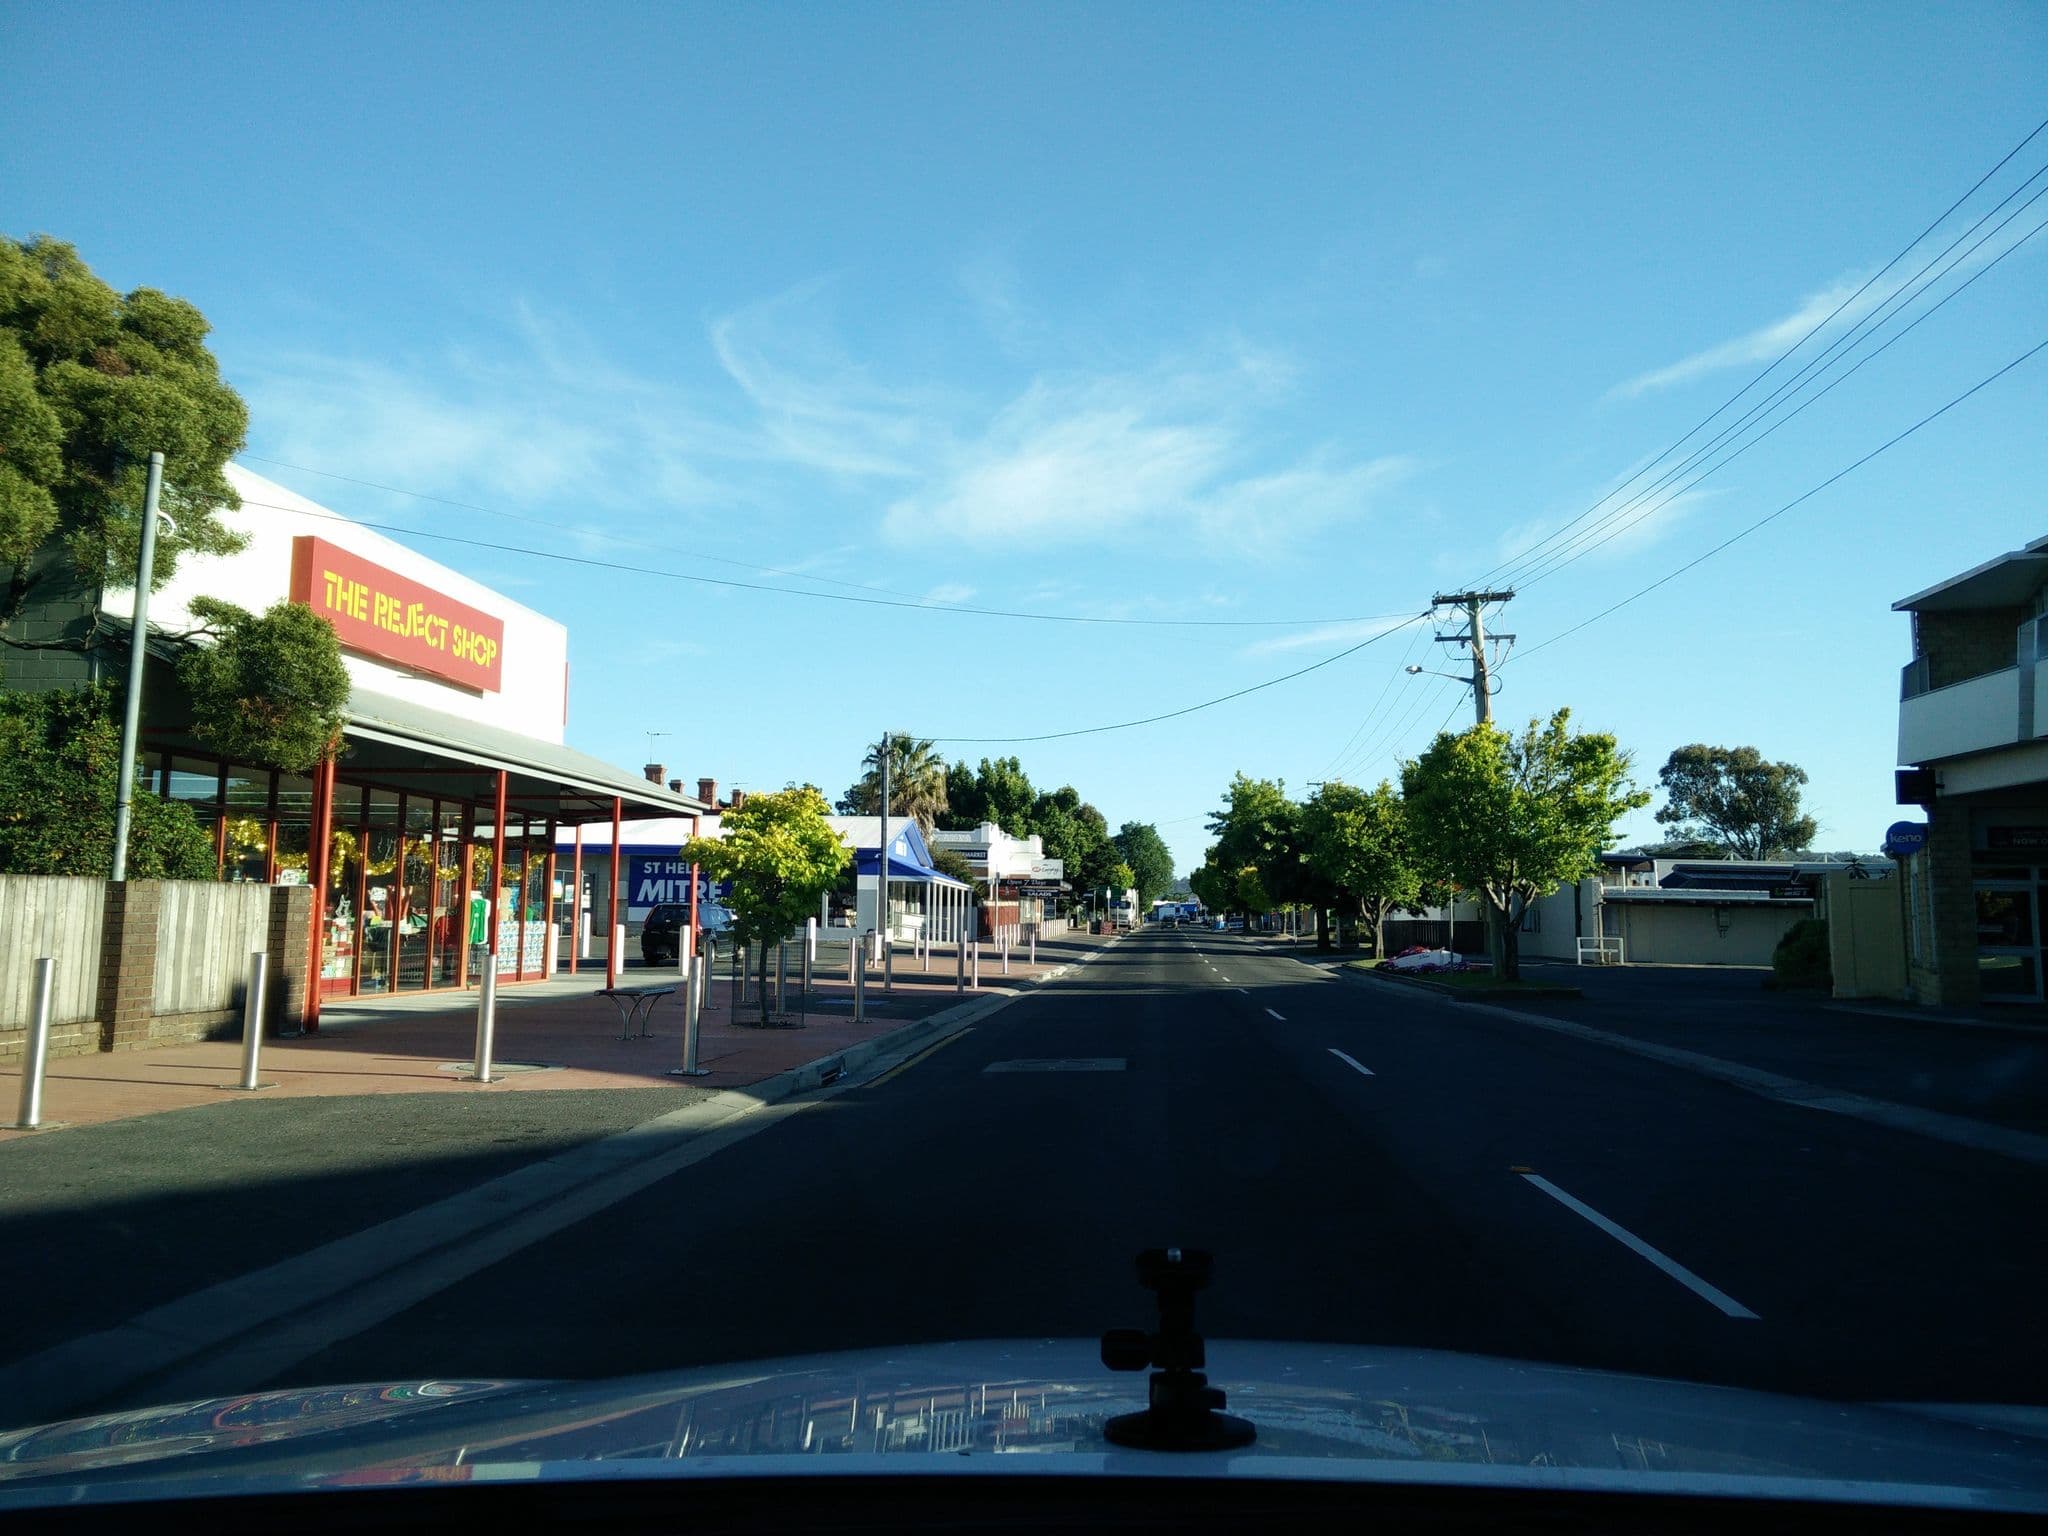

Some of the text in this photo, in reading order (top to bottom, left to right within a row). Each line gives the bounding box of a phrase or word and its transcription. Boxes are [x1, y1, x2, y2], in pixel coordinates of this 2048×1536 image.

[323, 570, 497, 668] THE REJECT SHOP
[1890, 833, 1922, 844] keno
[644, 862, 706, 874] ST HEL
[637, 879, 722, 902] MITRE
